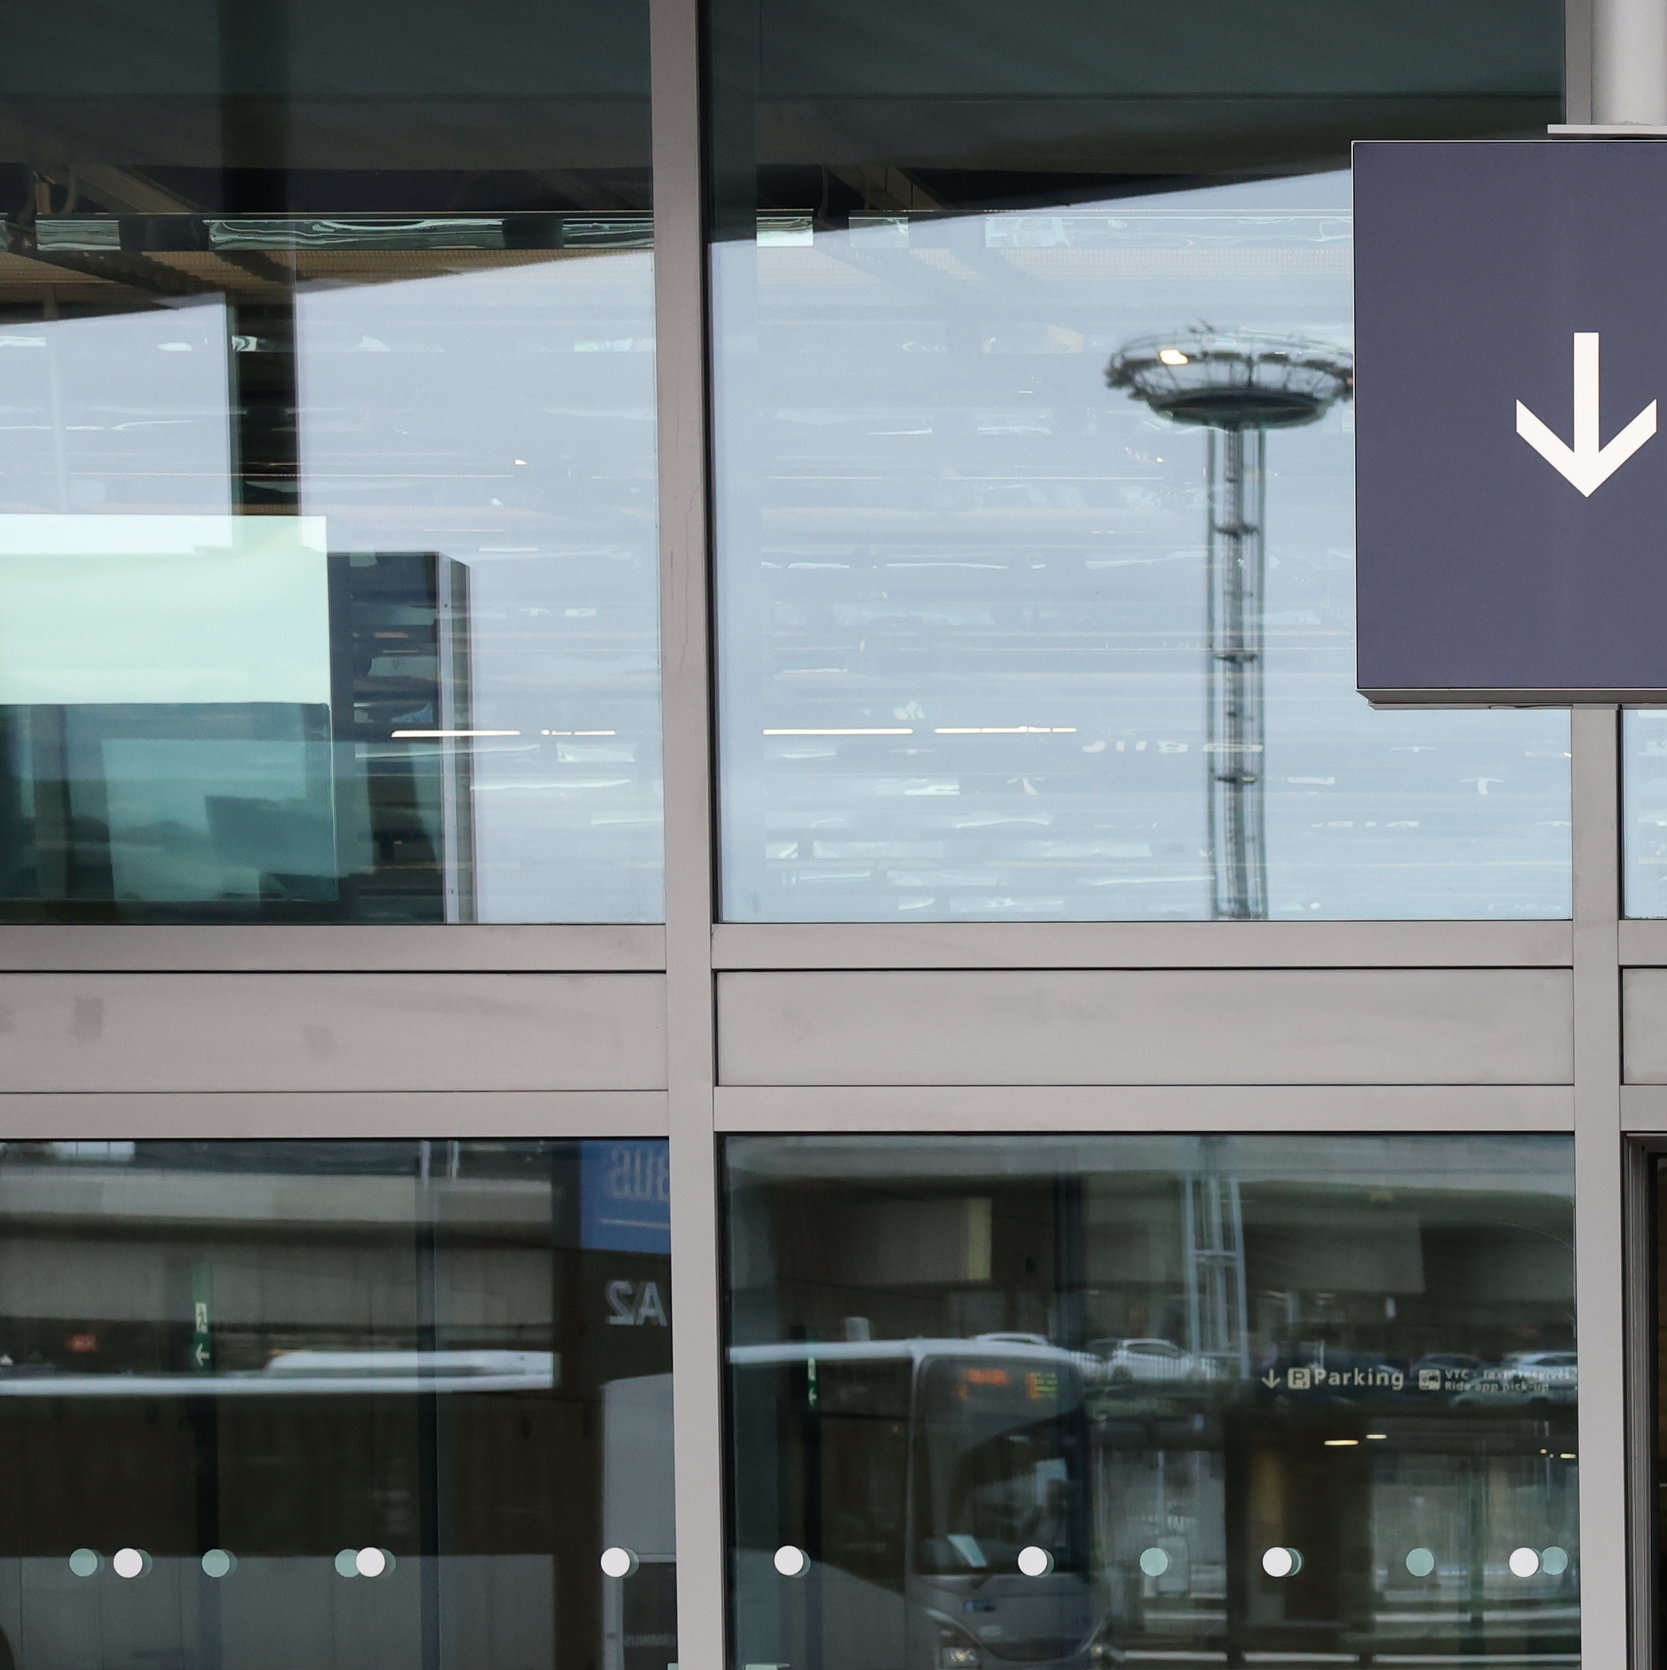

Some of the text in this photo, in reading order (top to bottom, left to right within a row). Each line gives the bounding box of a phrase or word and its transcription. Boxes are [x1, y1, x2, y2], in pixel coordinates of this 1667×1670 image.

[1314, 1368, 1404, 1390] Parking
[1445, 1369, 1471, 1379] VTC
[1445, 1381, 1549, 1392] Ride app pick-up
